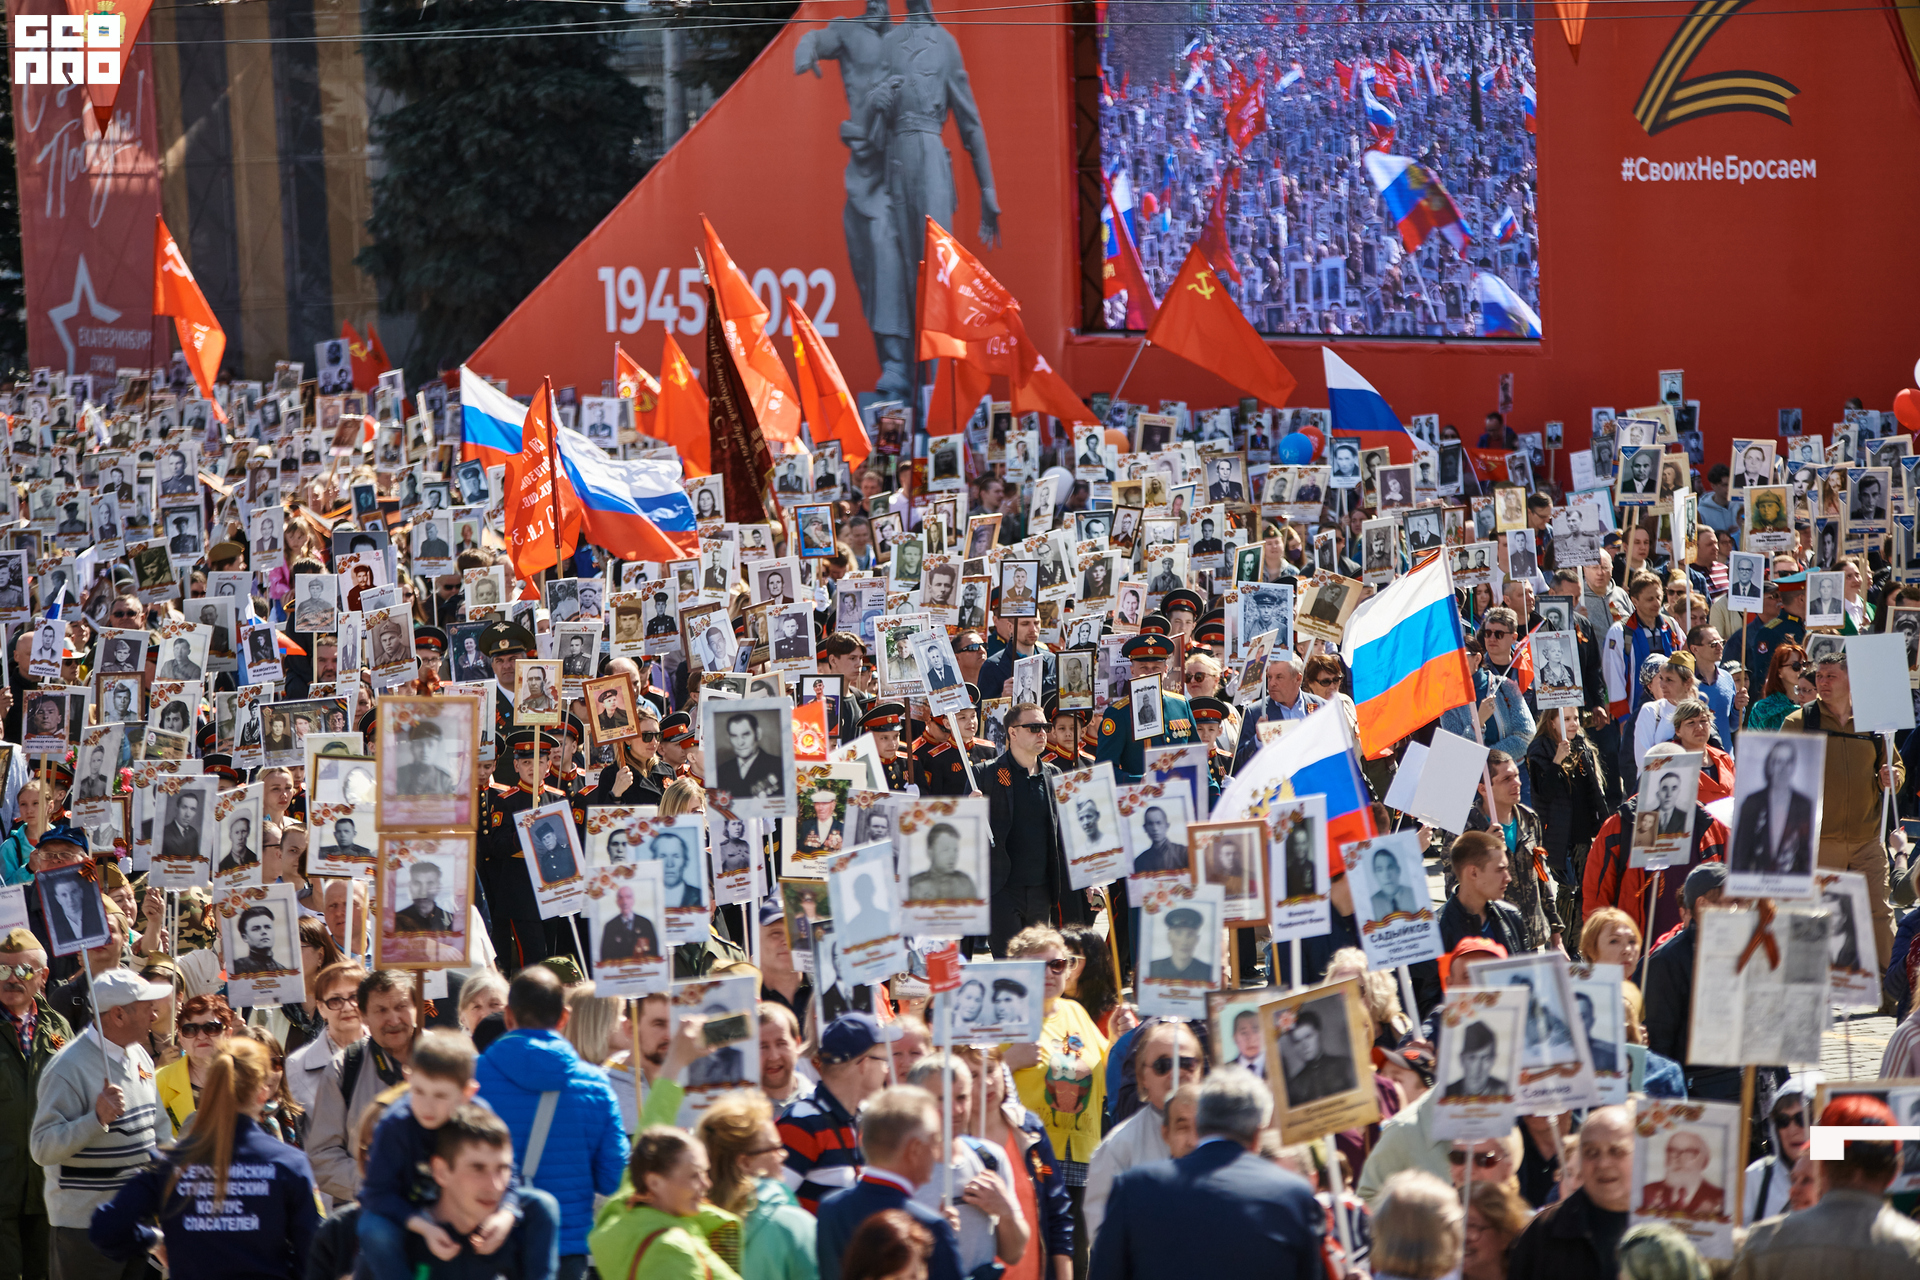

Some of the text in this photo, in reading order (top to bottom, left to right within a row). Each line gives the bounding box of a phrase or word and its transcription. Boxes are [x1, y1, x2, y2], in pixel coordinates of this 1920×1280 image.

[1621, 155, 1817, 185] #СвоихНеБросаем
[597, 265, 707, 336] 1945
[742, 266, 839, 338] 022
[172, 1162, 276, 1180] СЕРОСИЙСКИЙ
[182, 1213, 260, 1232] СПАСАТЕЛЕЙ
